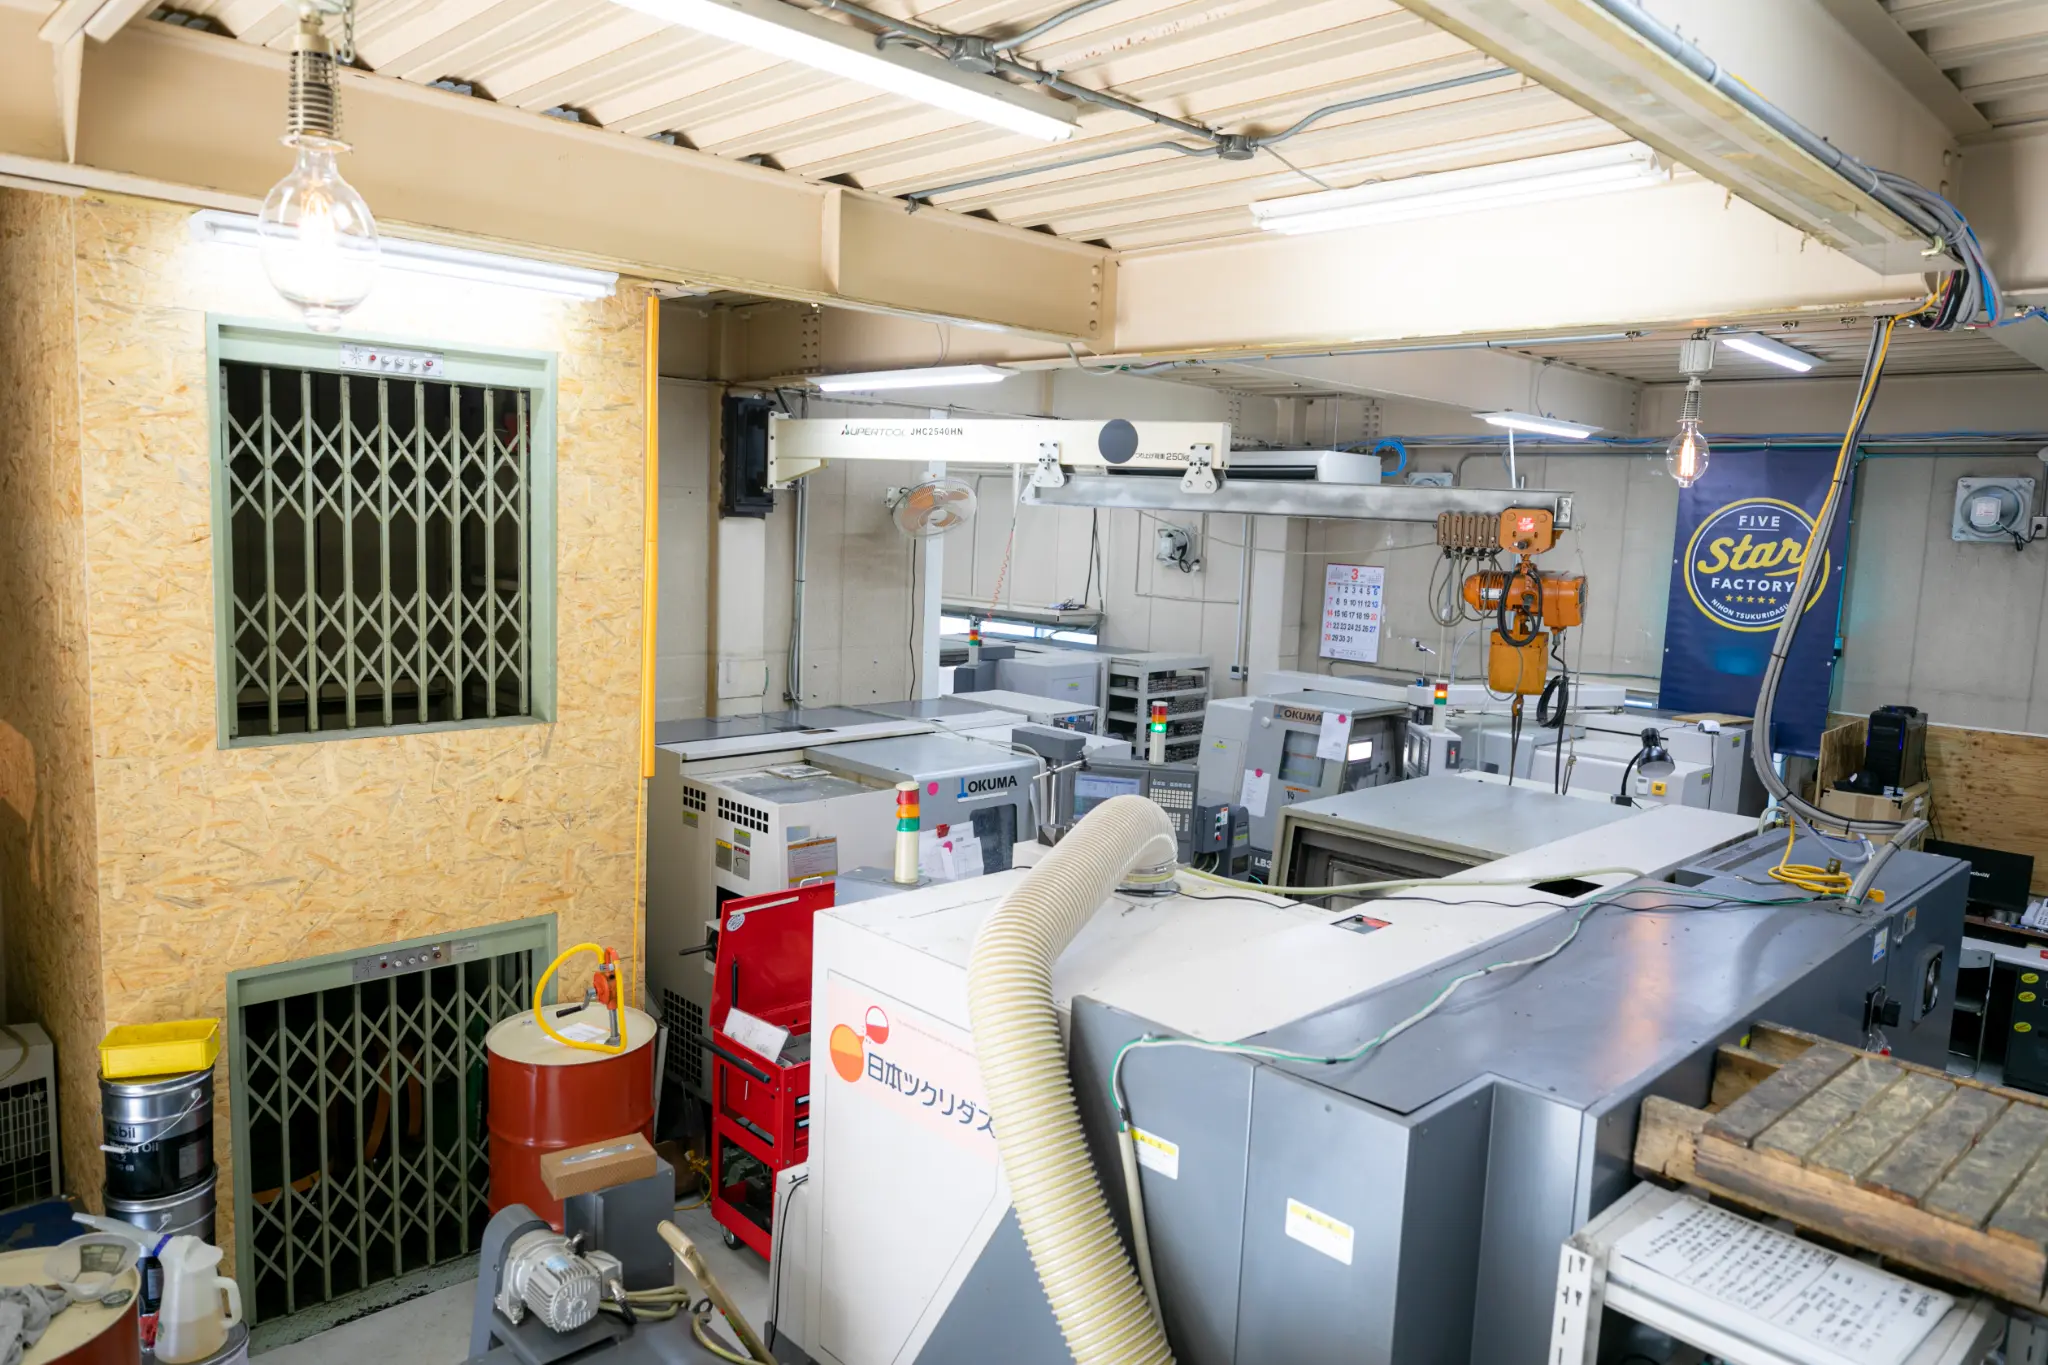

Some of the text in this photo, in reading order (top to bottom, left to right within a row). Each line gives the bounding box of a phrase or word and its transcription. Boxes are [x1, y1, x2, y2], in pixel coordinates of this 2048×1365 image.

[1738, 515, 1781, 528] FIVE
[1697, 533, 1803, 575] Star
[1351, 568, 1359, 580] 3
[1711, 577, 1795, 593] FACTORY
[1366, 588, 1370, 596] 5
[1373, 588, 1378, 596] 6
[1711, 598, 1735, 616] NIHON
[1284, 709, 1322, 722] OKUMA
[967, 775, 1018, 793] OKUMA
[1254, 856, 1272, 869] LB3
[868, 1052, 996, 1139] 日本ツクリダス
[142, 1142, 159, 1153] Oil
